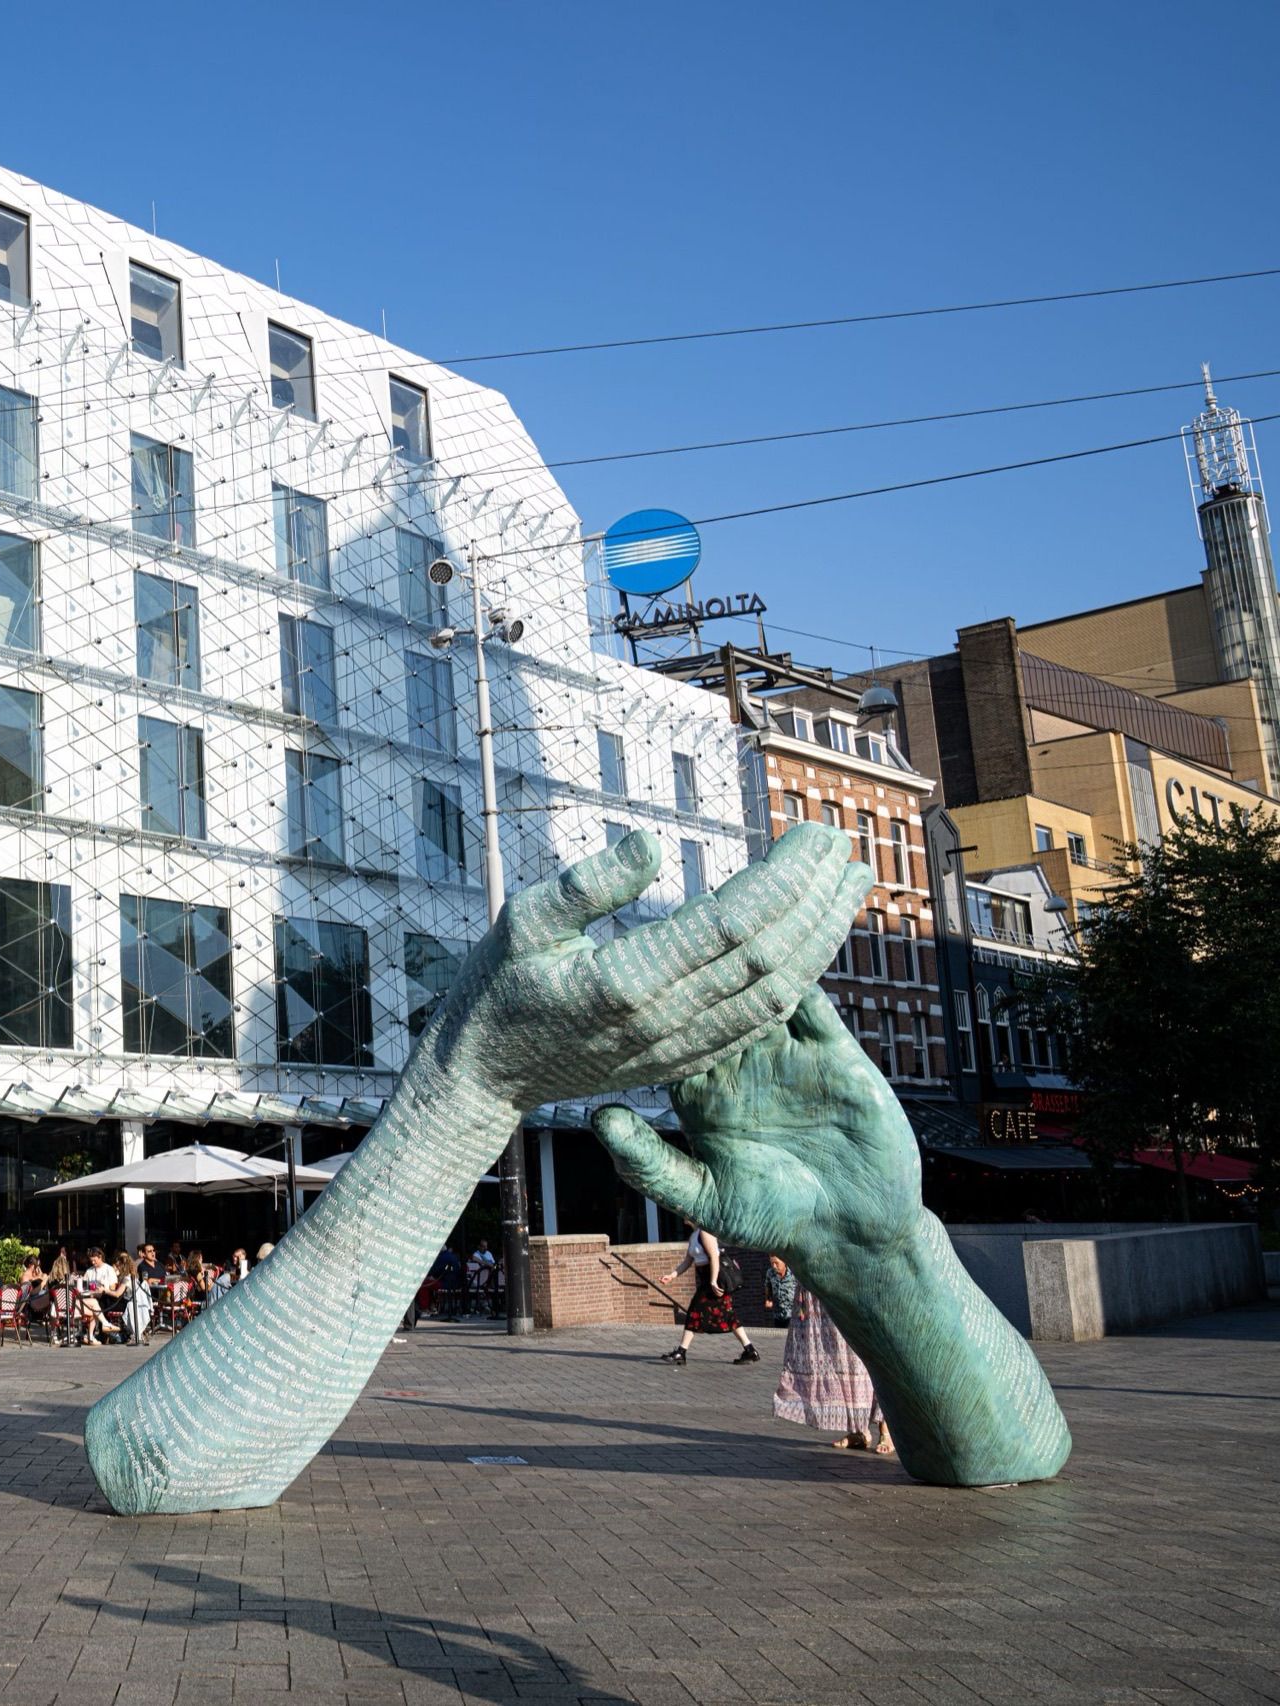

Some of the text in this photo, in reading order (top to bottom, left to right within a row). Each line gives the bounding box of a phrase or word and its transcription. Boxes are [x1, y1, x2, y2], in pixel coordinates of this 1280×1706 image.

[653, 592, 767, 627] MINOLTA
[608, 966, 624, 989] sens
[322, 1226, 346, 1245] nodig
